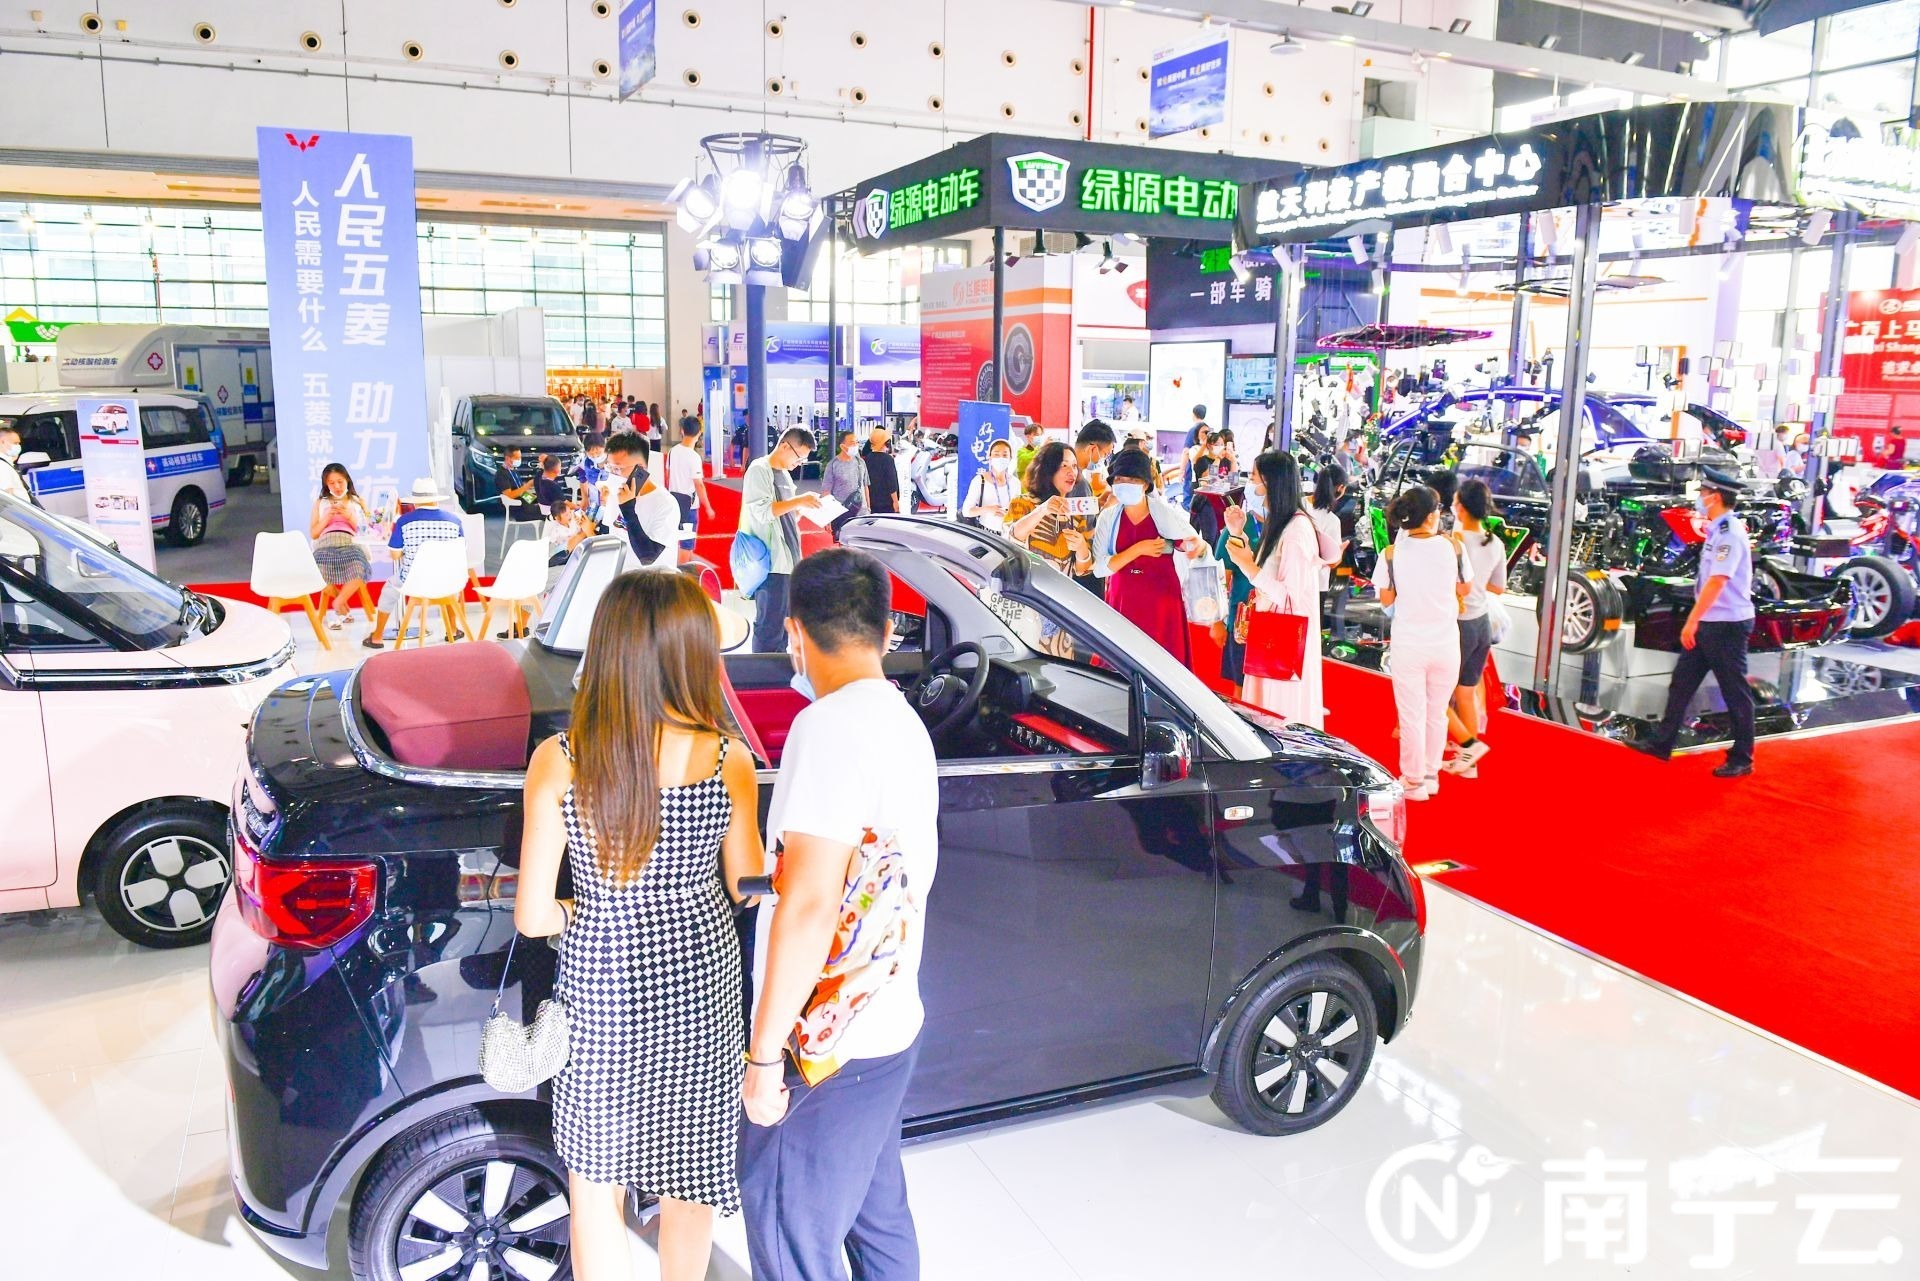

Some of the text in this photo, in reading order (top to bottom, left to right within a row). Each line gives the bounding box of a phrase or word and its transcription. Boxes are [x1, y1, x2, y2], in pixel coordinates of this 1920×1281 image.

[889, 168, 981, 230] 绿源电动车
[1080, 168, 1239, 220] 绿源电动
[334, 152, 393, 347] 人民五菱
[1190, 279, 1246, 305] 一部车
[292, 180, 334, 503] 人民需要什么 五菱就造
[1000, 608, 1023, 620] THE
